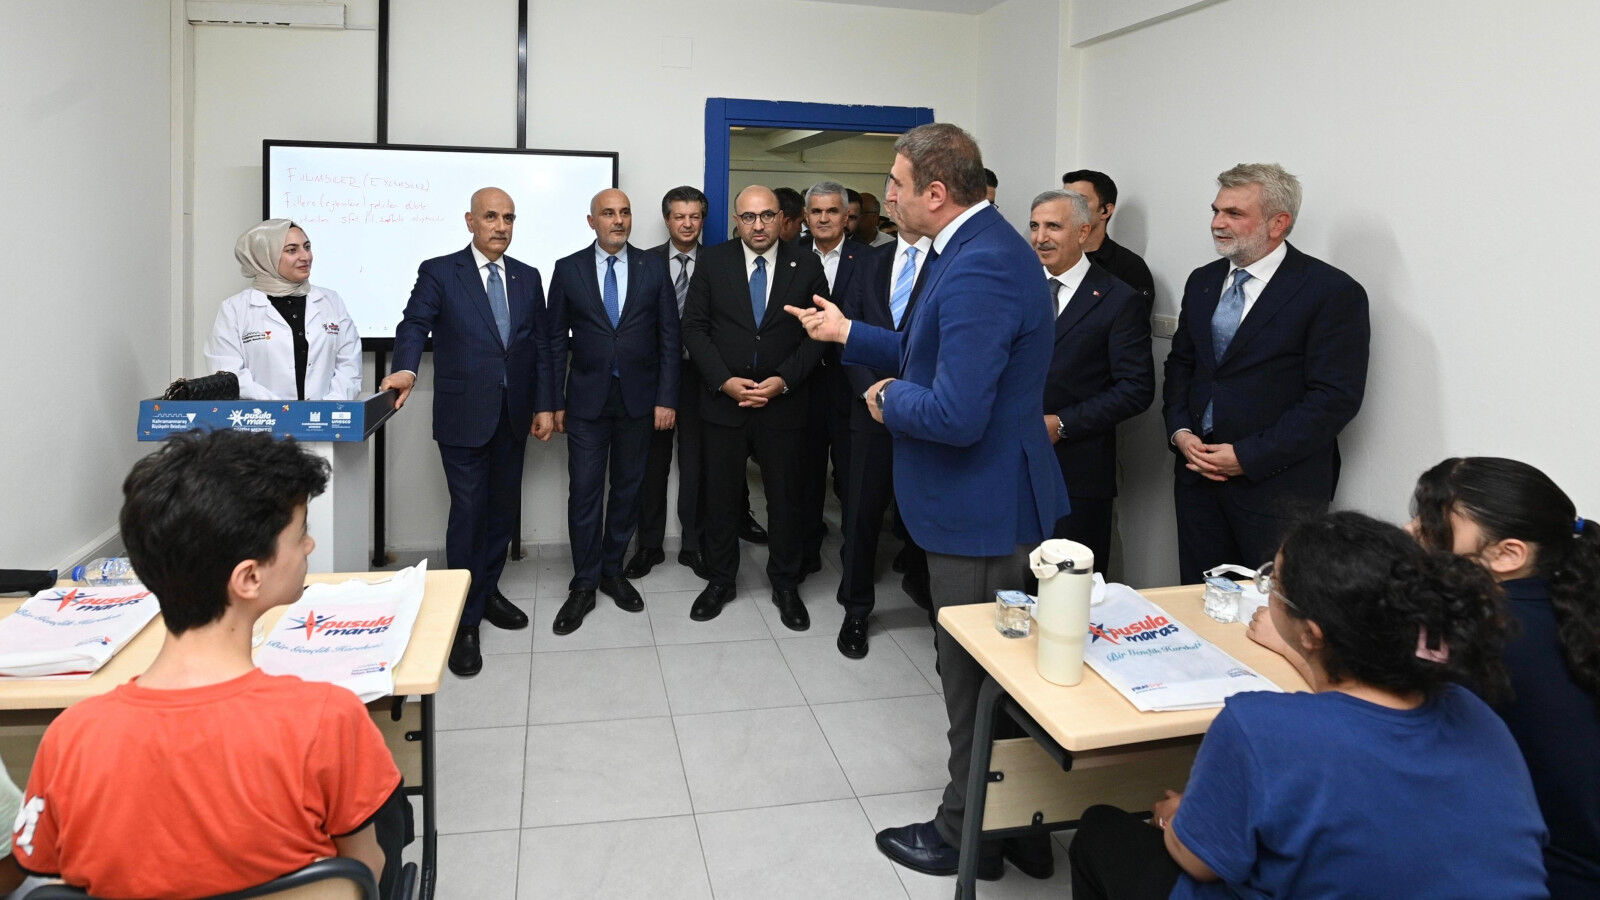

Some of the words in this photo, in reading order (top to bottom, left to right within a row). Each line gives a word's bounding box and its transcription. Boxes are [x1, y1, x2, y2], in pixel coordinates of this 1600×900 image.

[243, 411, 272, 421] pusula
[315, 615, 396, 633] pusula
[1107, 615, 1170, 640] pusula
[1125, 623, 1179, 643] maras
